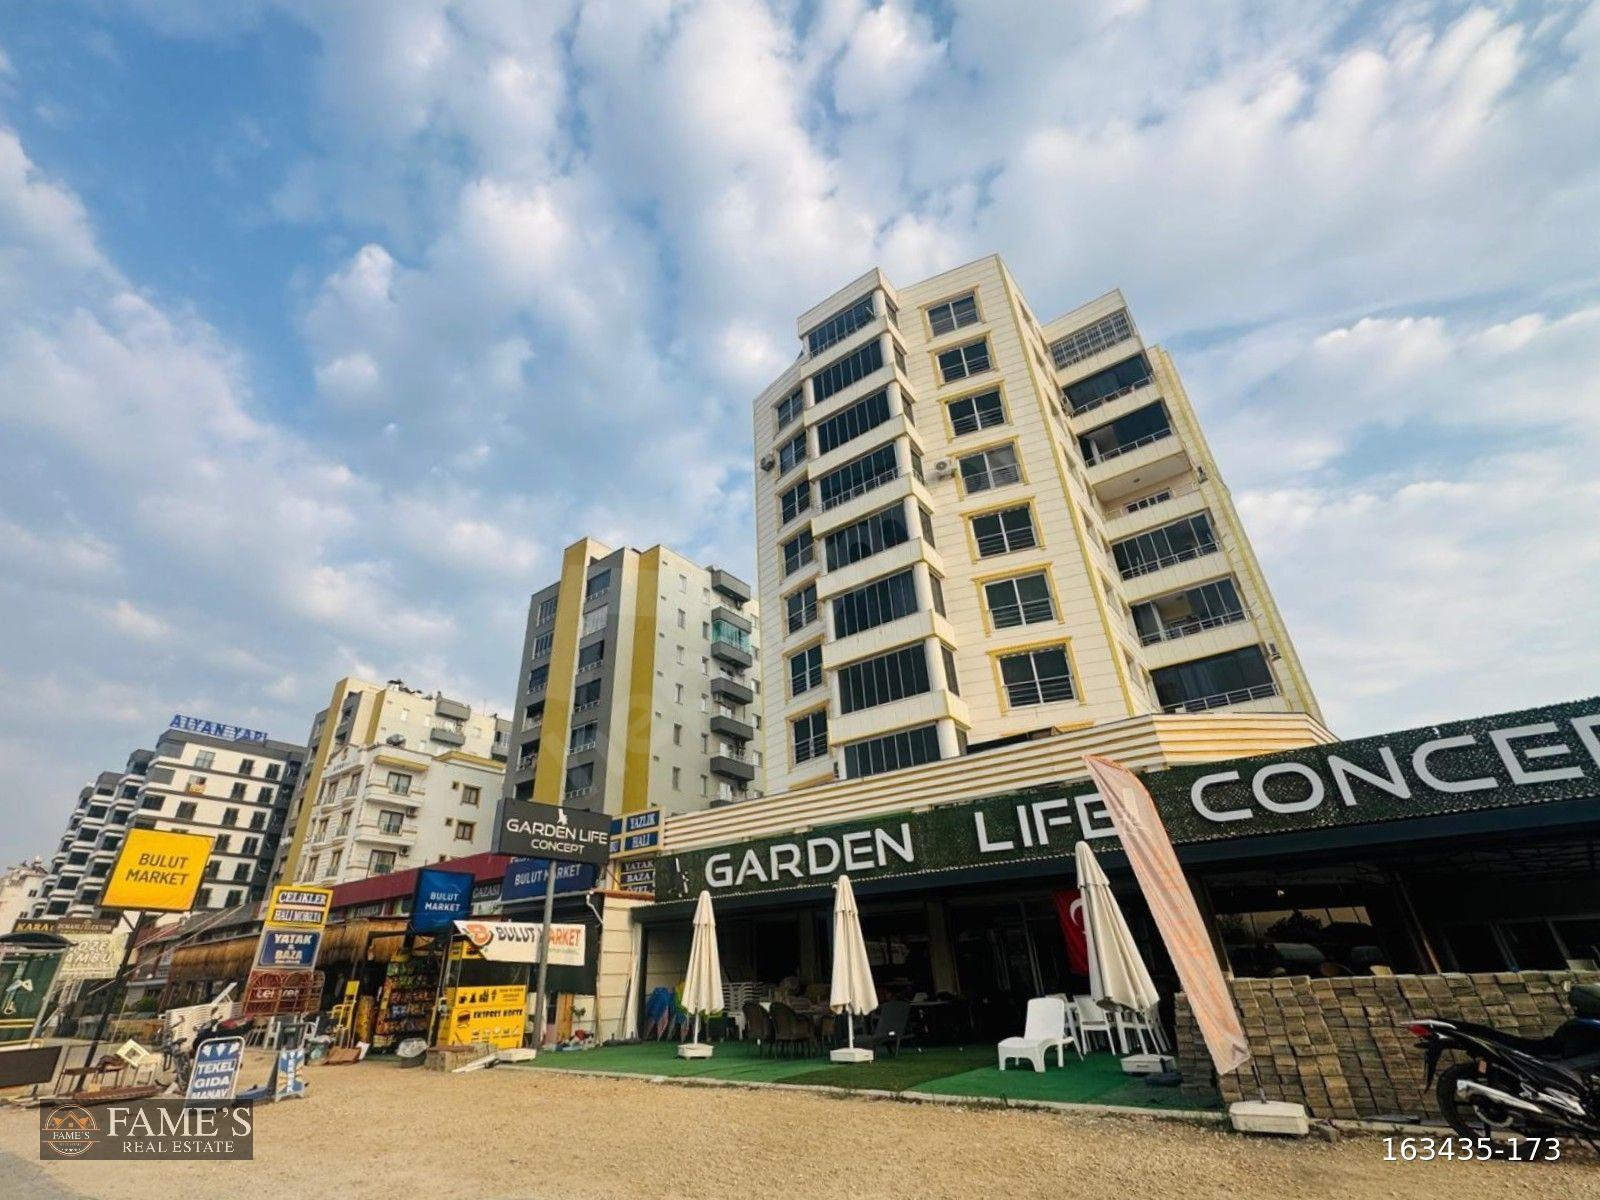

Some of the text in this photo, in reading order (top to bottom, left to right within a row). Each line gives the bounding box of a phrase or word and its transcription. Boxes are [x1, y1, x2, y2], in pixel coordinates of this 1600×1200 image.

[506, 818, 608, 845] GARDEN LIFE
[531, 838, 585, 854] CONCEPT
[705, 823, 914, 888] GARDEN
[974, 793, 1119, 853] LIFE
[138, 852, 189, 869] BULUT
[625, 860, 654, 871] YATAK
[125, 868, 190, 886] MARKET
[514, 870, 543, 886] BULUT
[627, 873, 650, 882] BAZA
[430, 892, 459, 901] BULUT
[425, 902, 460, 912] MARKET
[274, 934, 312, 944] YATAK
[496, 926, 535, 943] BULUT
[275, 950, 303, 960] BAZA
[196, 1061, 235, 1075] TEKEL
[194, 1076, 230, 1089] GIDA
